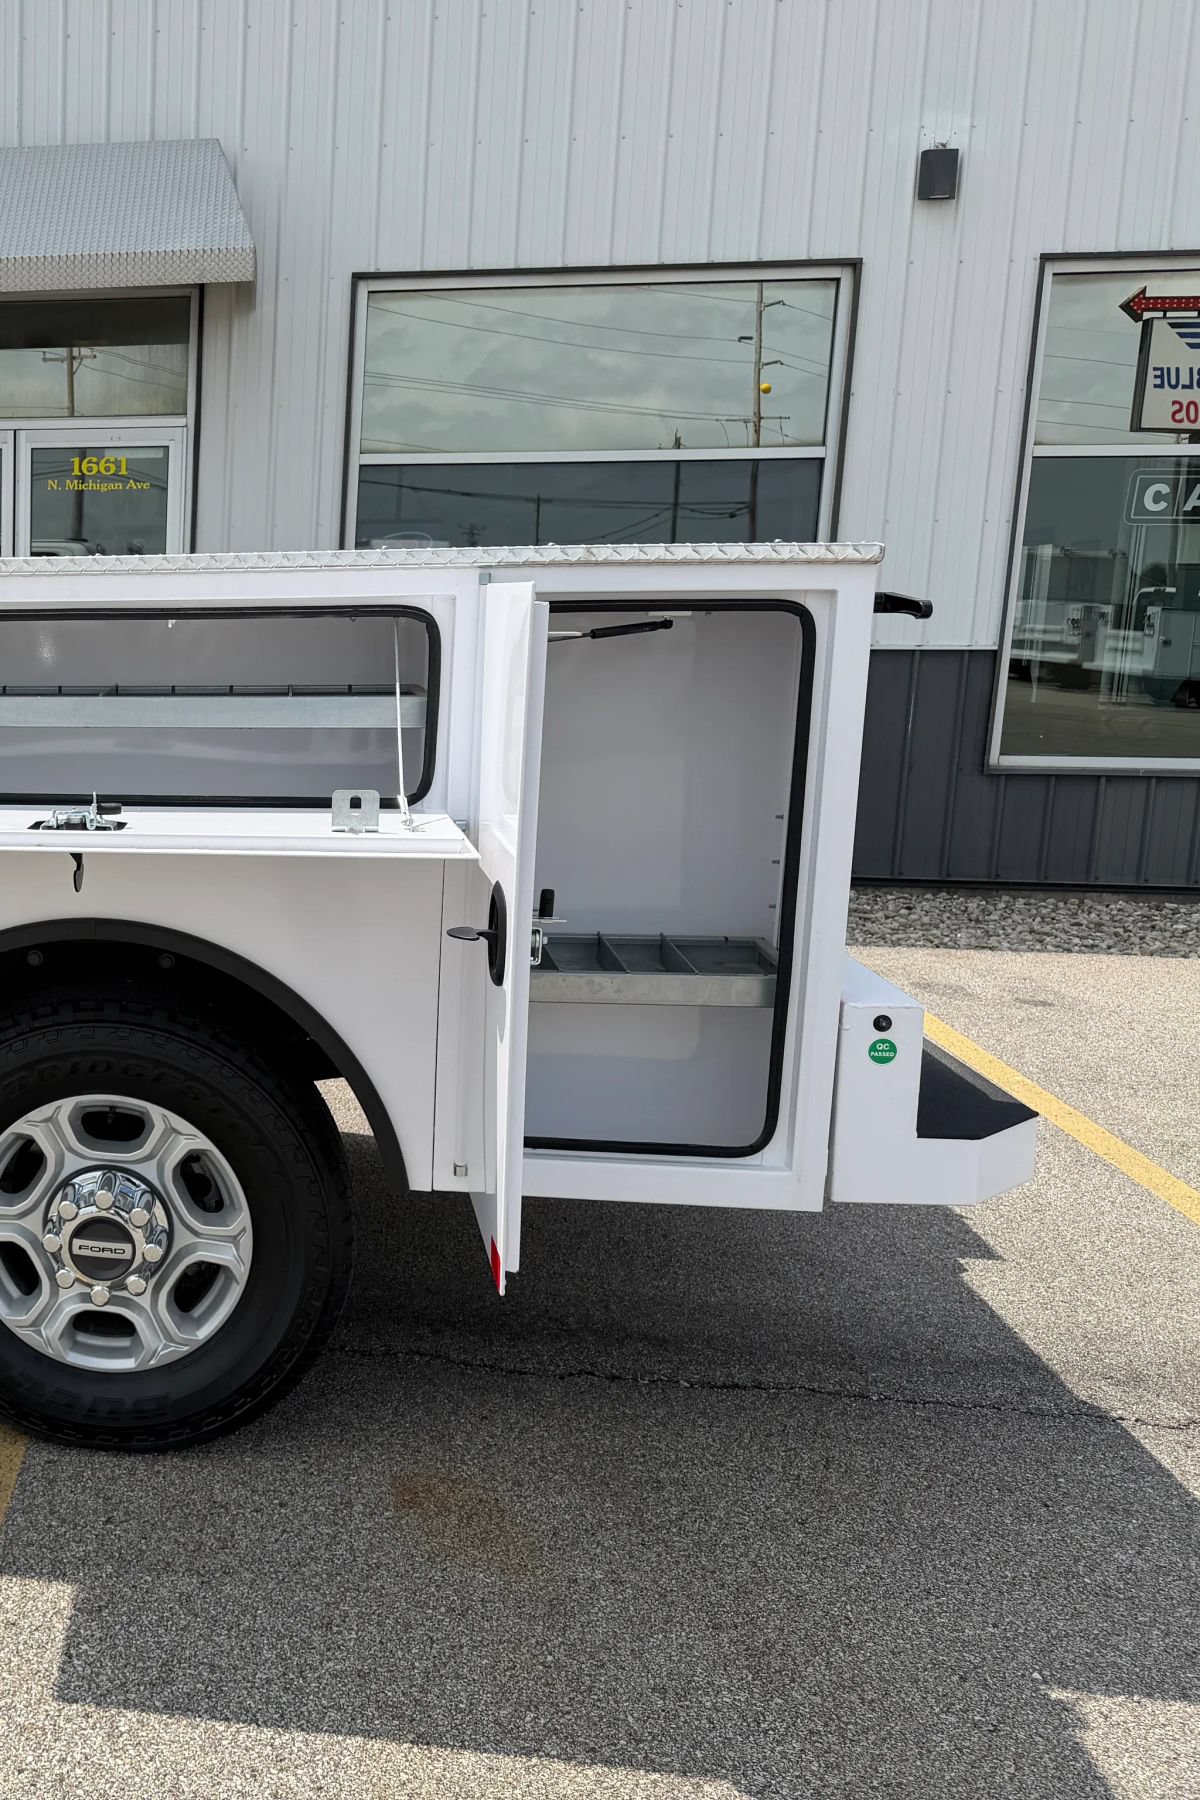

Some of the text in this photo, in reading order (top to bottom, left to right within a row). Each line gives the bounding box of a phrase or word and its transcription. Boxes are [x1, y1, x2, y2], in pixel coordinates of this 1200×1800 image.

[70, 456, 128, 476] 1661
[47, 479, 150, 492] N. Michigan Ave
[876, 1043, 890, 1051] QC
[78, 1244, 126, 1255] FORD
